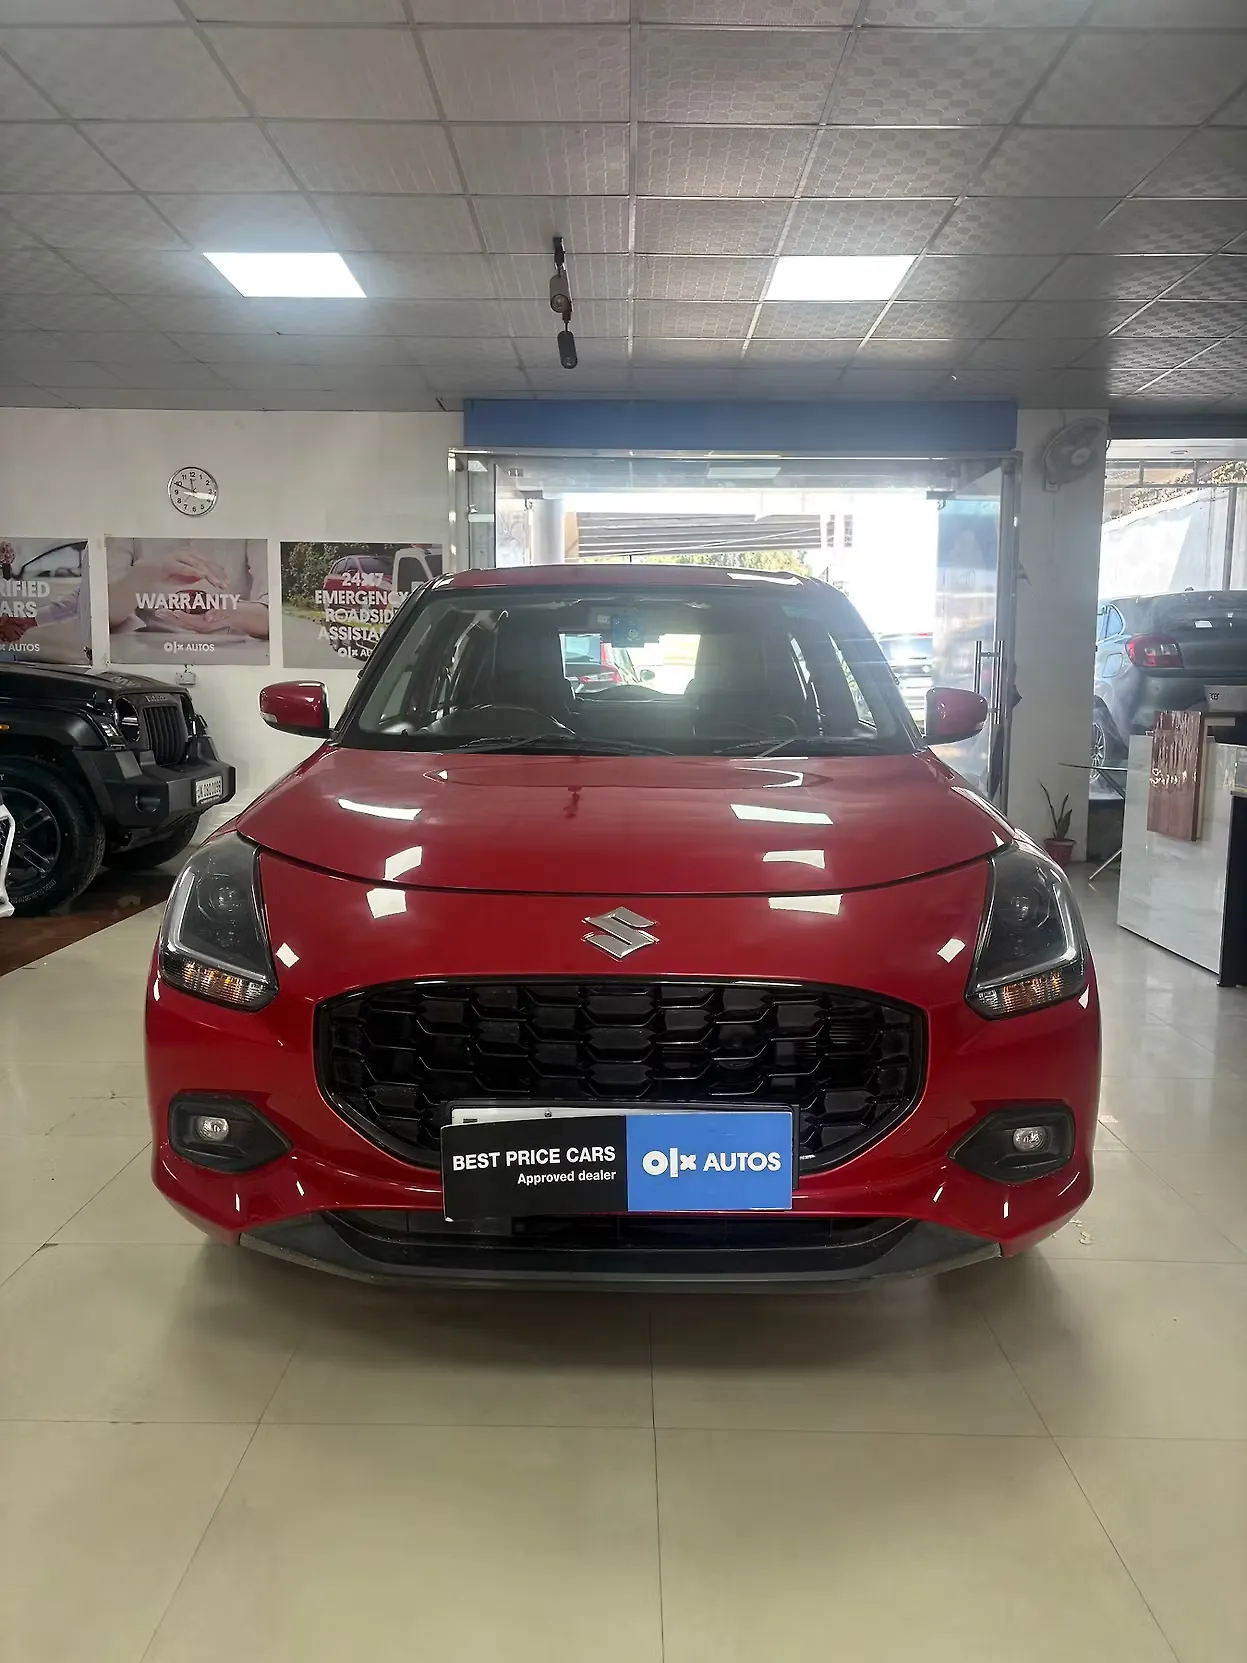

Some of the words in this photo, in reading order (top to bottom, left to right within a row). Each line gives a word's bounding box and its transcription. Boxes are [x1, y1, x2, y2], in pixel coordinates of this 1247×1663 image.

[135, 593, 241, 610] WARRANTY
[325, 608, 398, 623] ROADSID
[8, 643, 40, 652] AUTOS
[185, 643, 215, 652] AUTOS
[452, 1152, 501, 1171] BEST
[506, 1148, 561, 1167] PRICE
[566, 1145, 616, 1163] CARS
[702, 1152, 782, 1171] AUTOS
[517, 1170, 575, 1186] Approved
[578, 1169, 617, 1181] dealer
